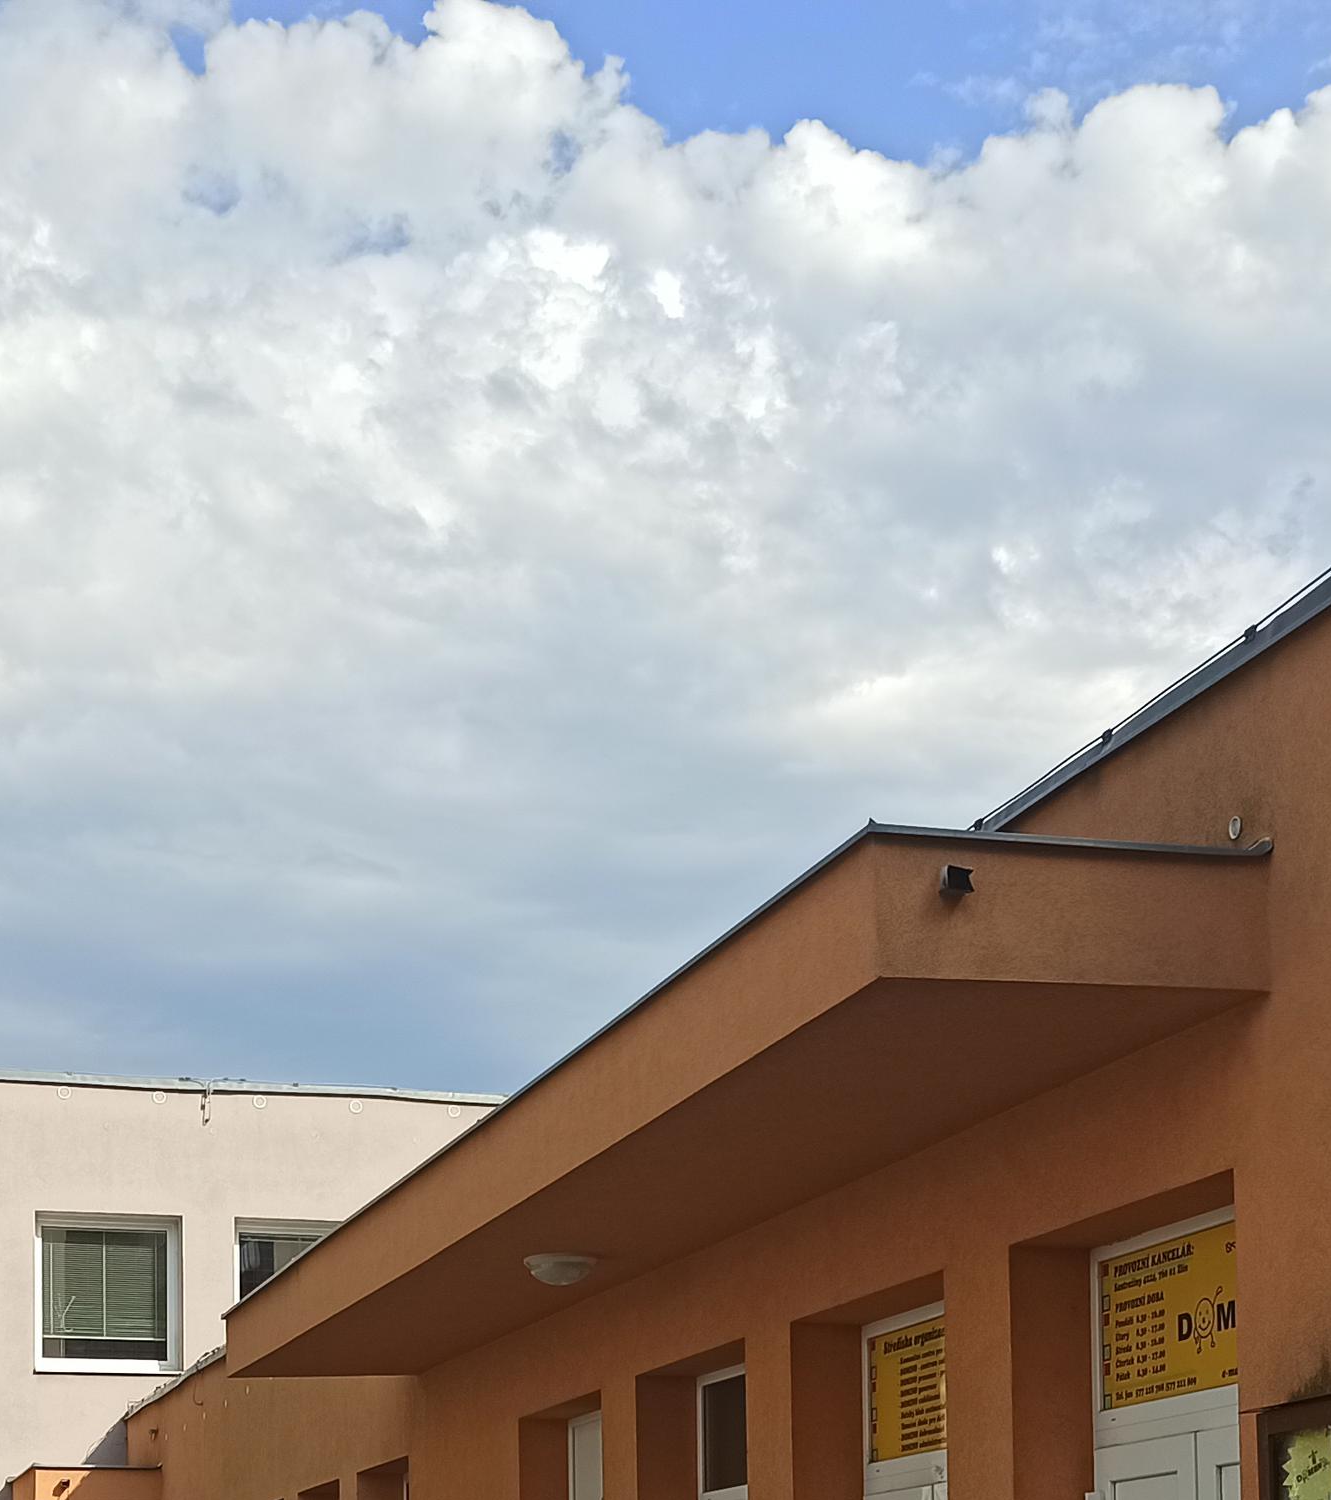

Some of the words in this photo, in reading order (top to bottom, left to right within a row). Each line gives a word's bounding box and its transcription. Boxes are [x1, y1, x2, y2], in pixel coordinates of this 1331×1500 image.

[1114, 1254, 1150, 1278] PROVOZNÍ
[1151, 1240, 1195, 1268] KANCELÁŘ:
[1115, 1294, 1146, 1313] PROVOZNÍ
[1147, 1290, 1165, 1305] DOBA
